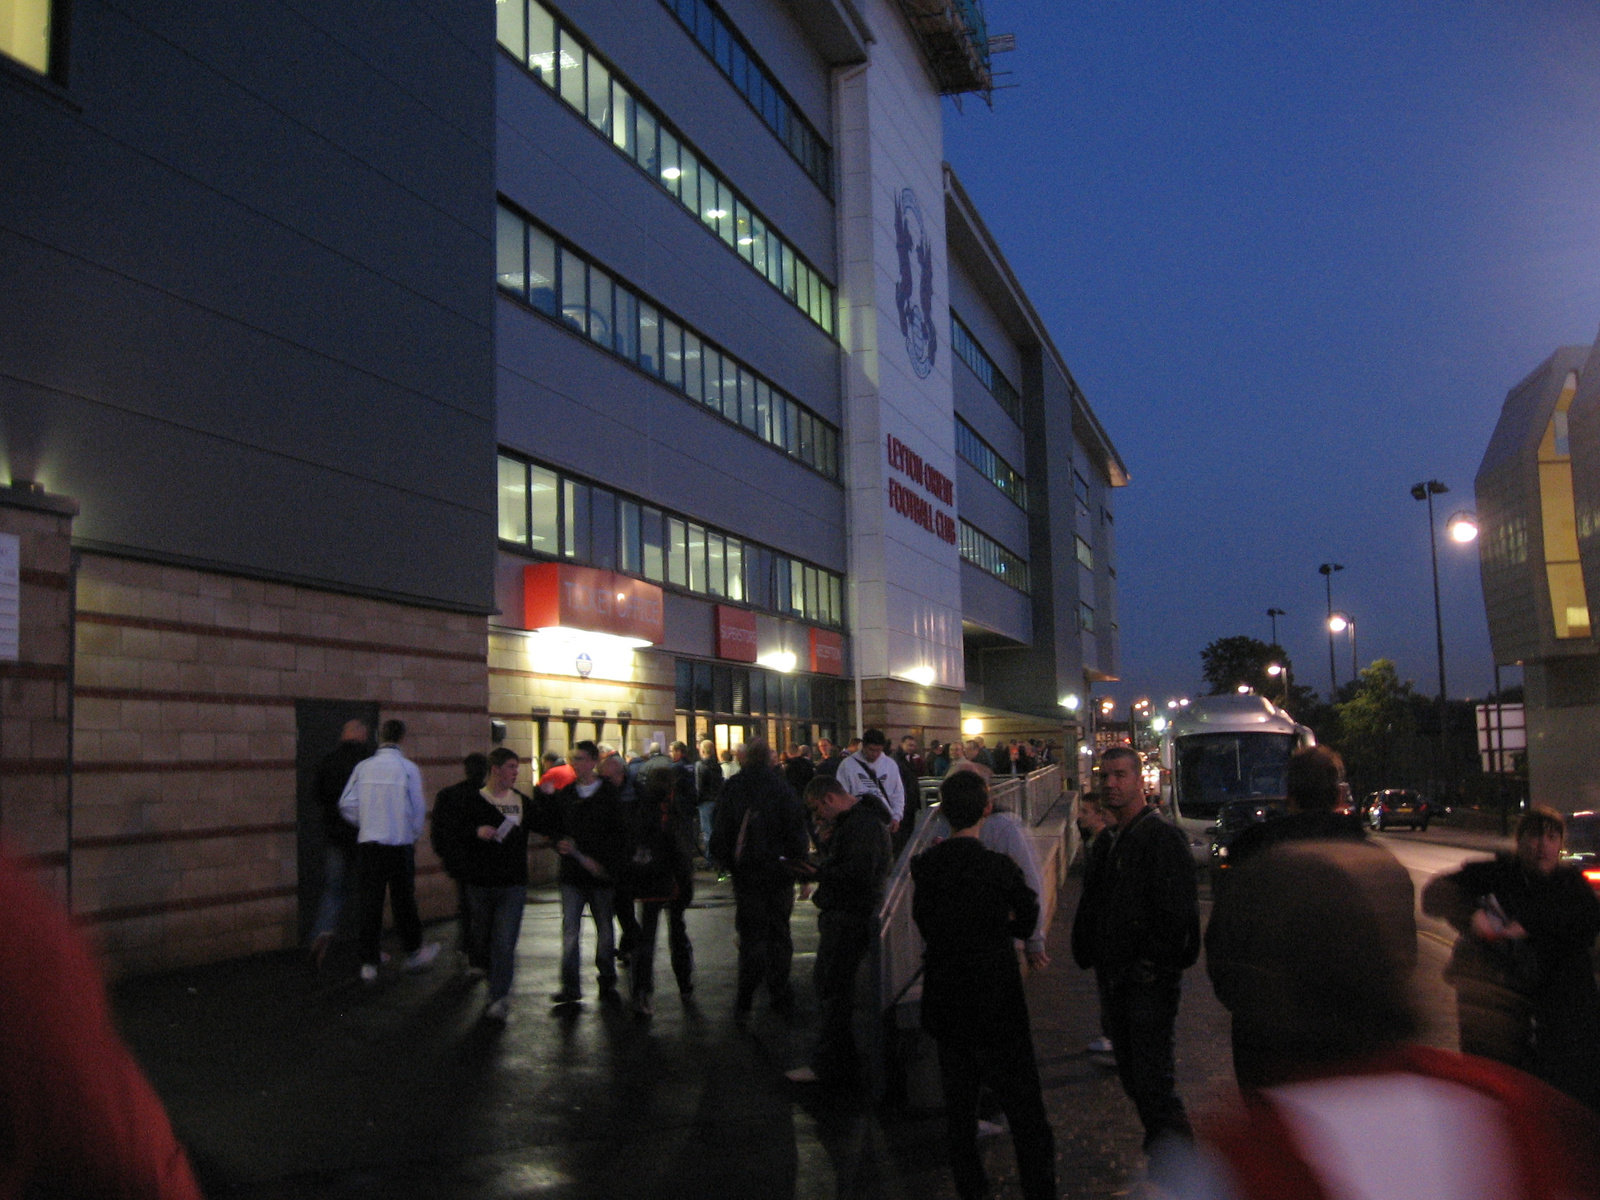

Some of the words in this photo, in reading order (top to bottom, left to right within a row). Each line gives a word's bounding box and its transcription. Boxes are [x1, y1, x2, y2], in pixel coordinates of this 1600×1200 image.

[887, 433, 924, 487] LEYTON
[889, 477, 935, 534] FOOTBALL
[935, 509, 956, 545] CLUB
